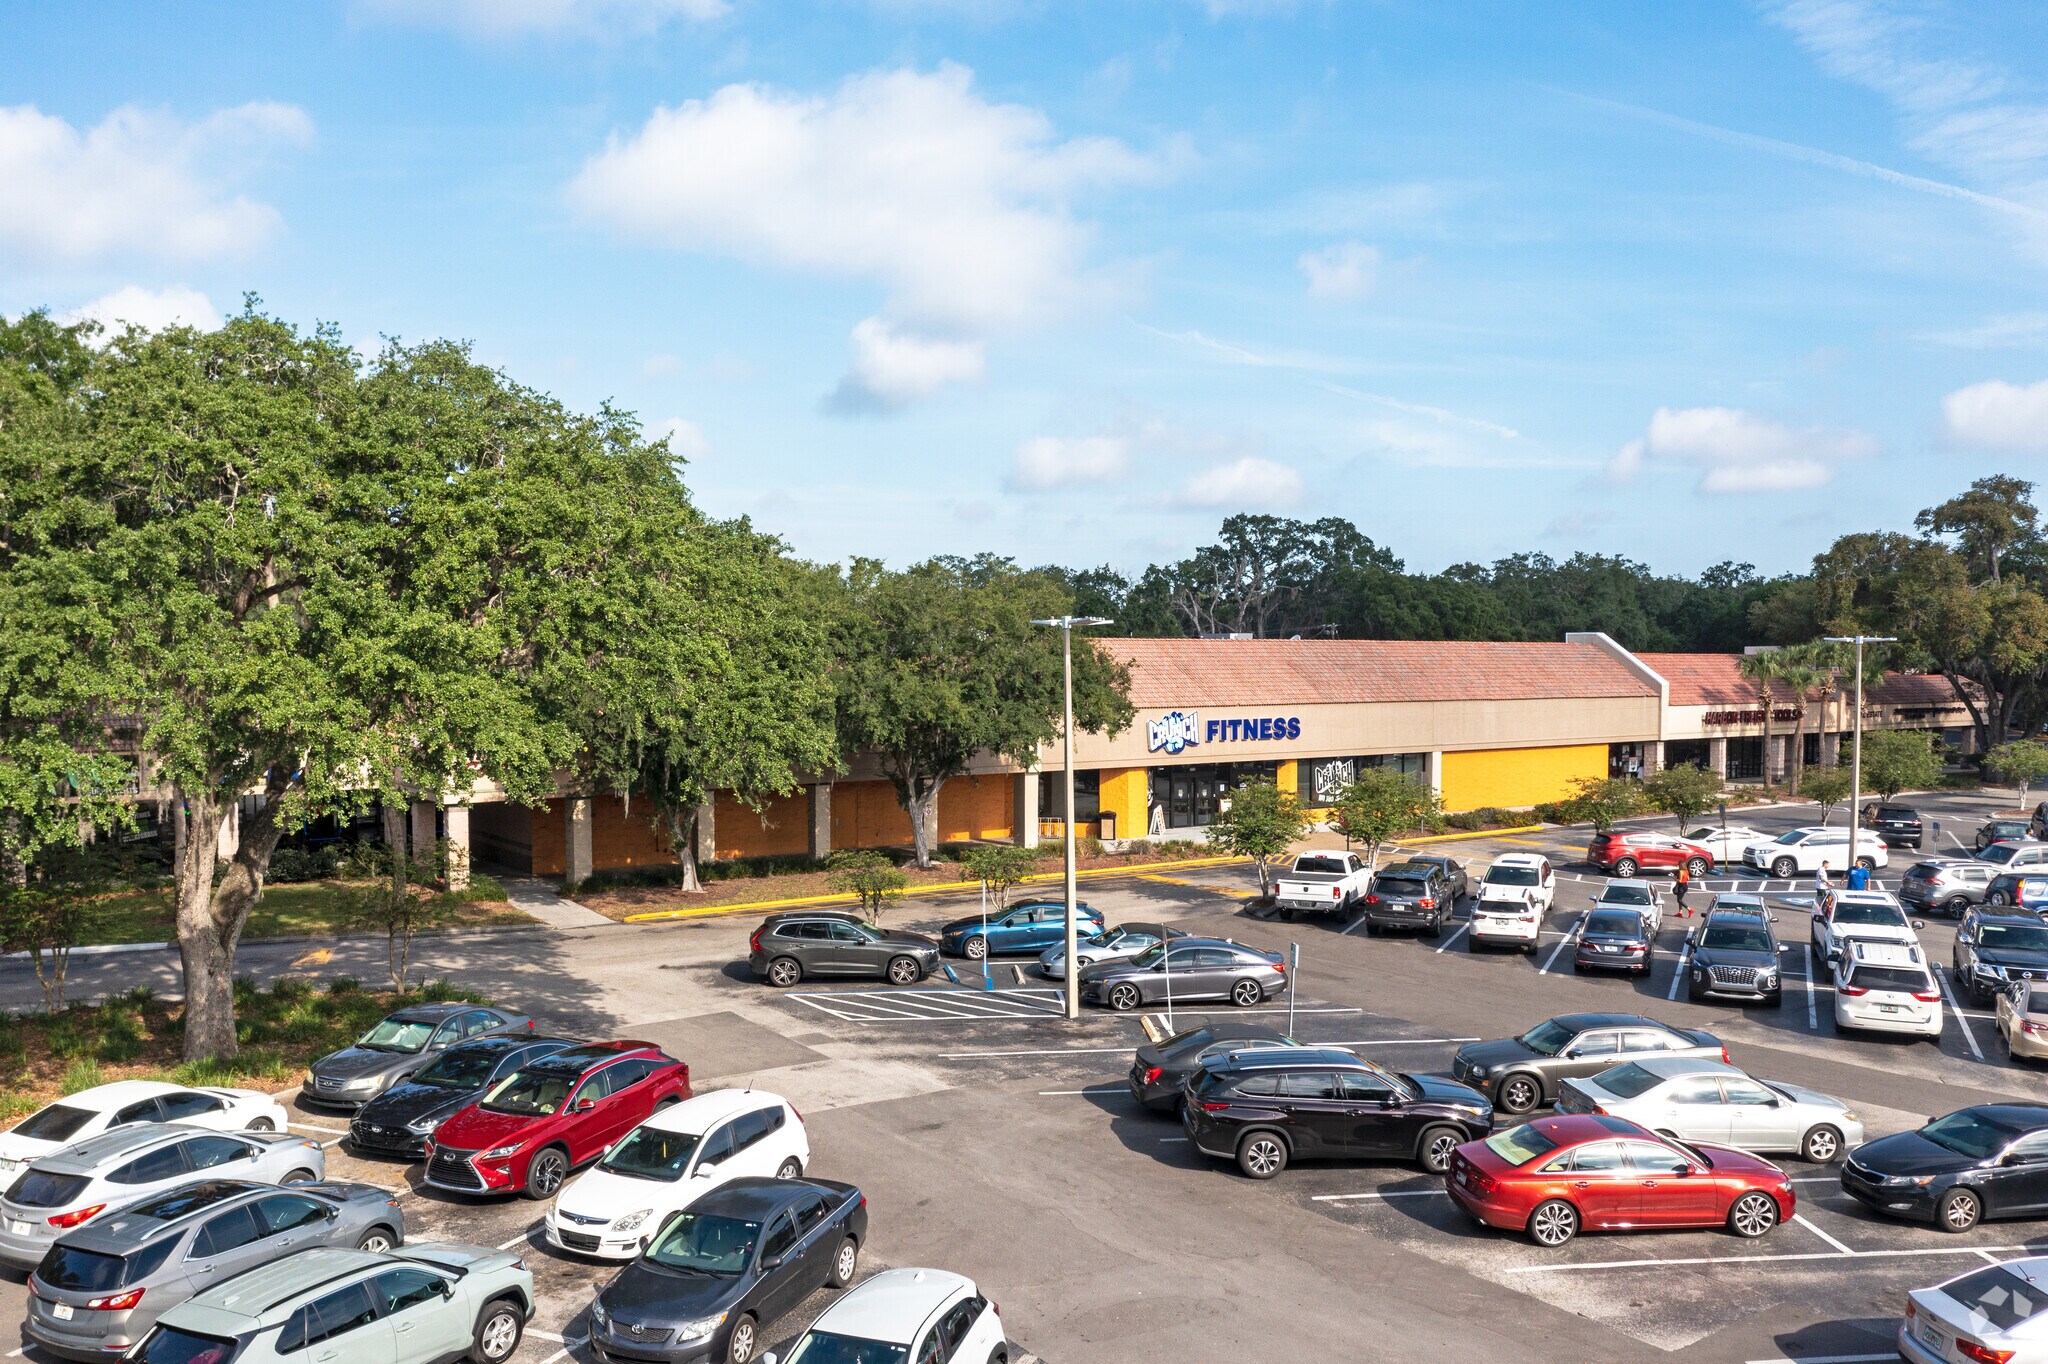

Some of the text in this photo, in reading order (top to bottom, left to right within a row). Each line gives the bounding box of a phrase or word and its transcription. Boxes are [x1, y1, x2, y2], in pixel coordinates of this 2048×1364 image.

[1148, 711, 1301, 752] CRUNCH FITNESS
[1315, 759, 1354, 793] CRUNCH
